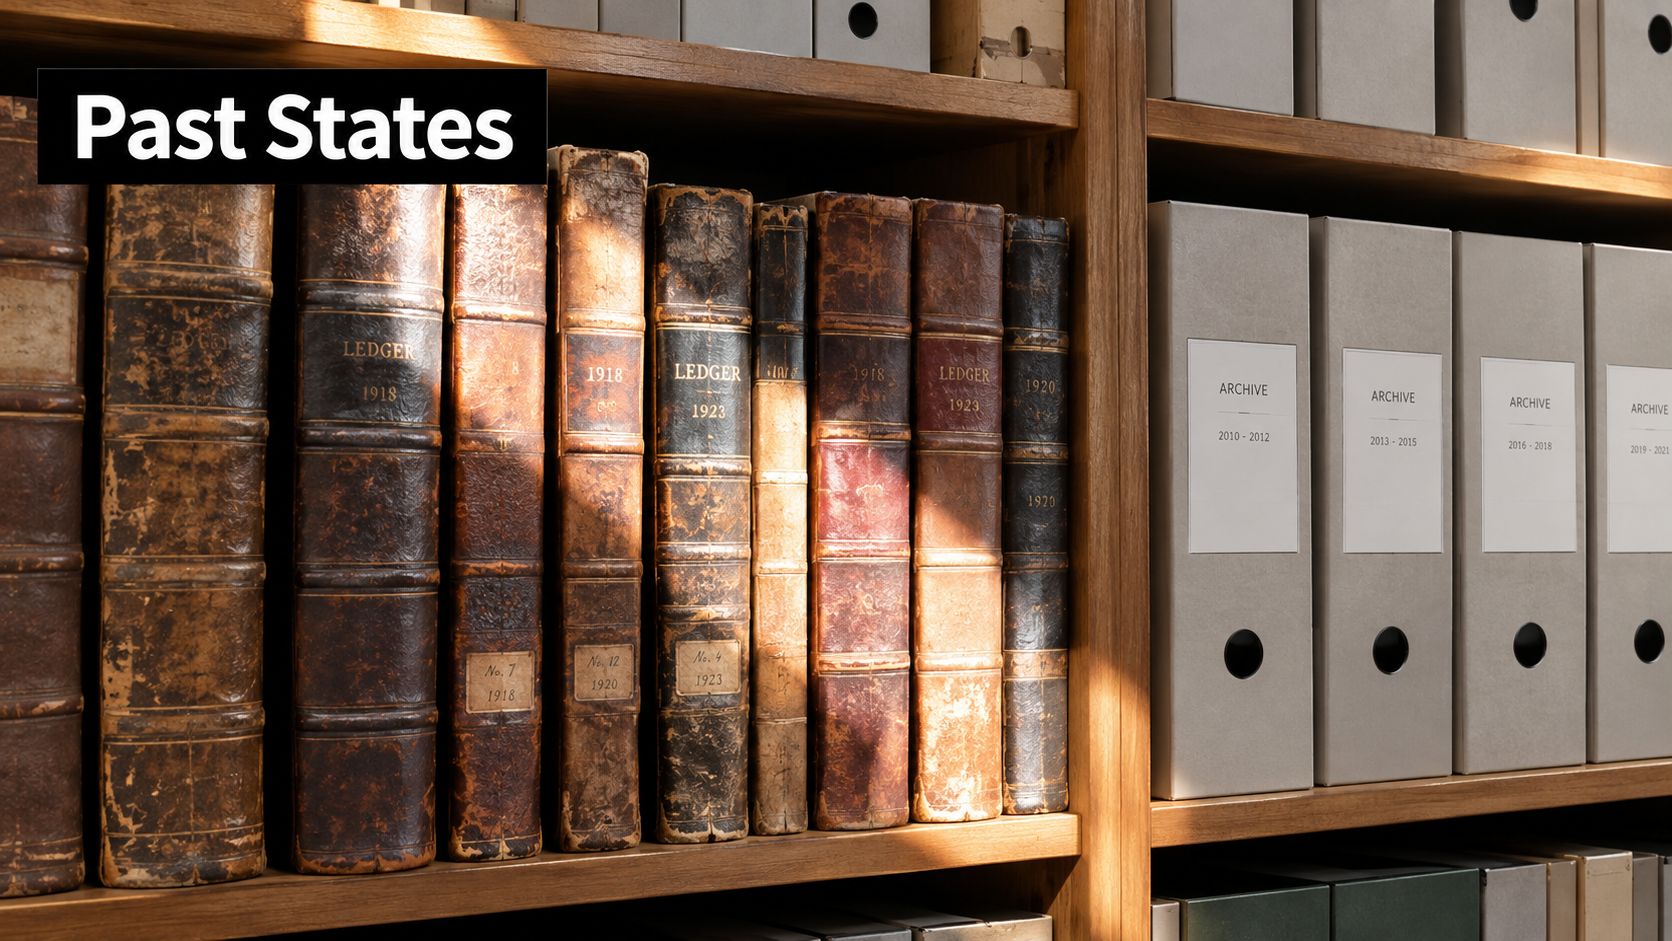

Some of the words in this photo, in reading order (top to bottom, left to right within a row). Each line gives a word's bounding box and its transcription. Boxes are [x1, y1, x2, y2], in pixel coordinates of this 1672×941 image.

[343, 341, 416, 360] LEDGER
[587, 366, 623, 383] 1918
[674, 363, 742, 381] LEDGER
[940, 366, 990, 383] LEDGER
[1026, 379, 1056, 394] 1920
[1219, 382, 1269, 397] ARCHIVE
[362, 386, 398, 402] 1918
[1371, 390, 1416, 404] ARCHIVE
[1509, 396, 1551, 410] ARCHIVE
[1631, 403, 1669, 416] ARCHIVE
[692, 404, 726, 419] 1923
[1218, 431, 1240, 441] 2010
[1249, 432, 1270, 442] 2012
[1370, 436, 1390, 446] 2013
[1398, 437, 1417, 447] 2015
[1508, 440, 1527, 450] 2016
[1534, 441, 1553, 451] 2018
[1630, 445, 1647, 455] 2019
[1654, 445, 1670, 455] 2021
[587, 655, 605, 668] No.
[608, 655, 620, 667] 12
[693, 651, 711, 663] No.
[715, 651, 722, 662] 4
[485, 664, 504, 677] No.
[509, 663, 517, 678] 7
[592, 679, 618, 691] 1920
[694, 674, 723, 687] 1923
[487, 688, 516, 702] 1918
